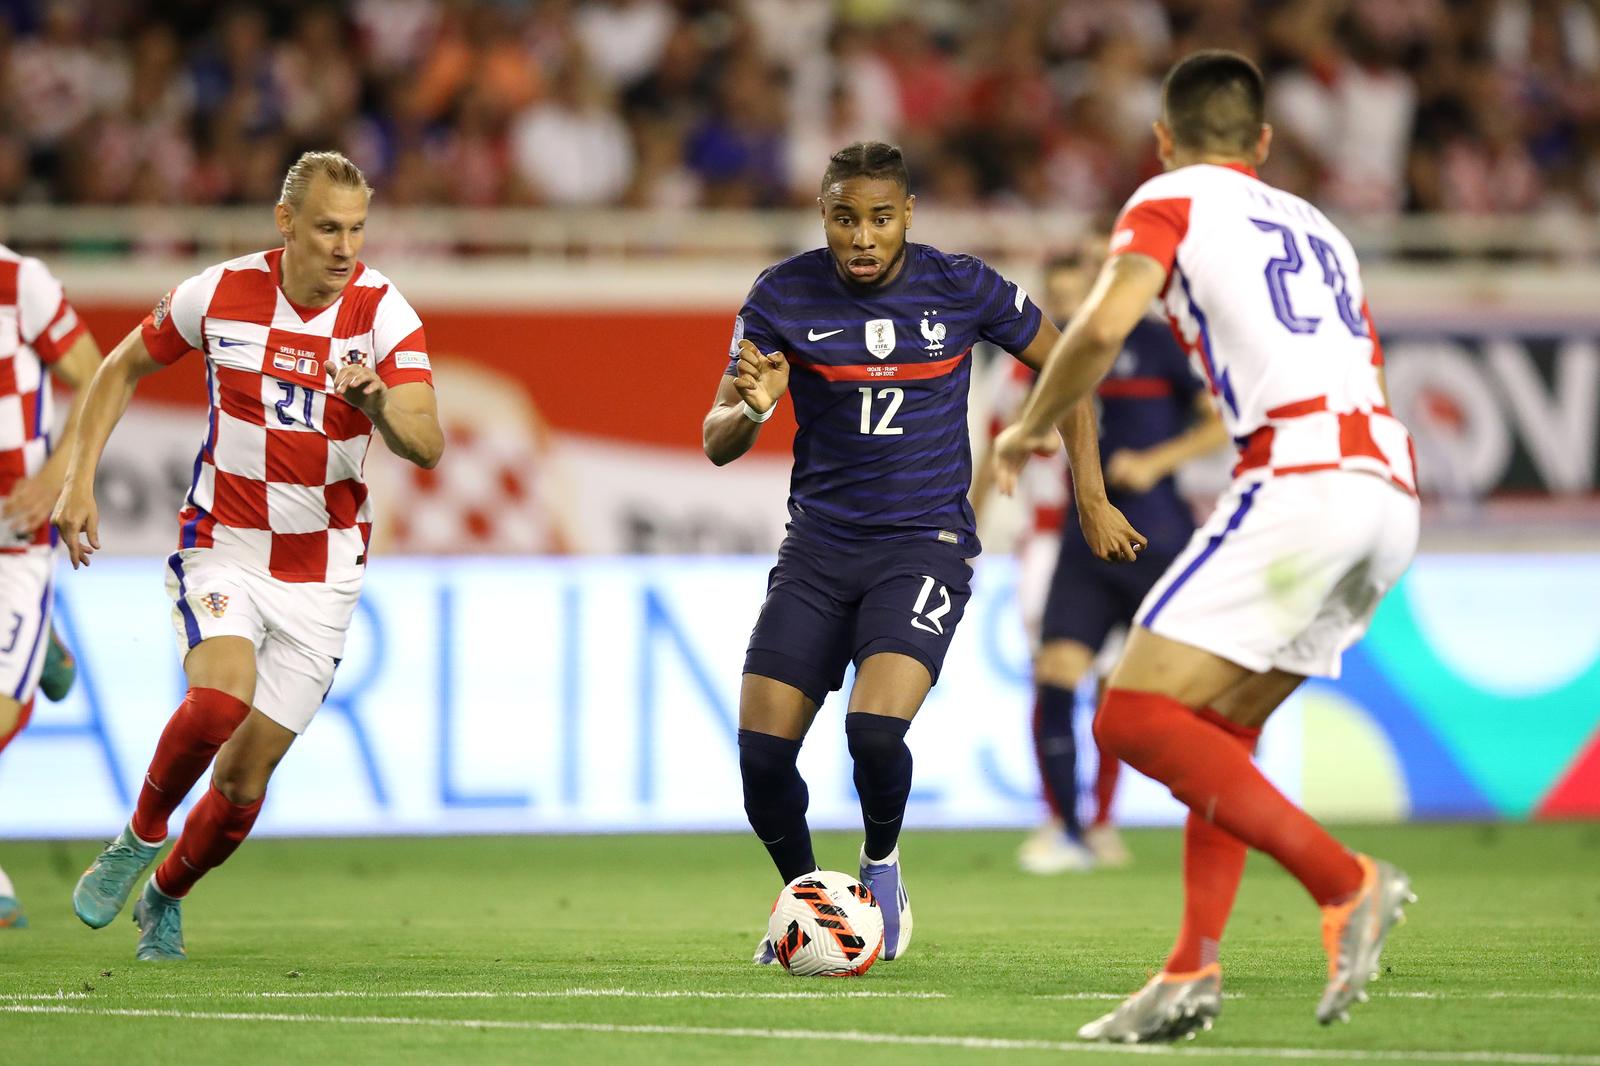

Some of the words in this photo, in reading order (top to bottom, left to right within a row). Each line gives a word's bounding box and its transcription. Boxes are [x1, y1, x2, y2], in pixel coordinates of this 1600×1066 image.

[275, 381, 314, 429] 21
[858, 386, 905, 436] 12
[912, 575, 952, 635] 12
